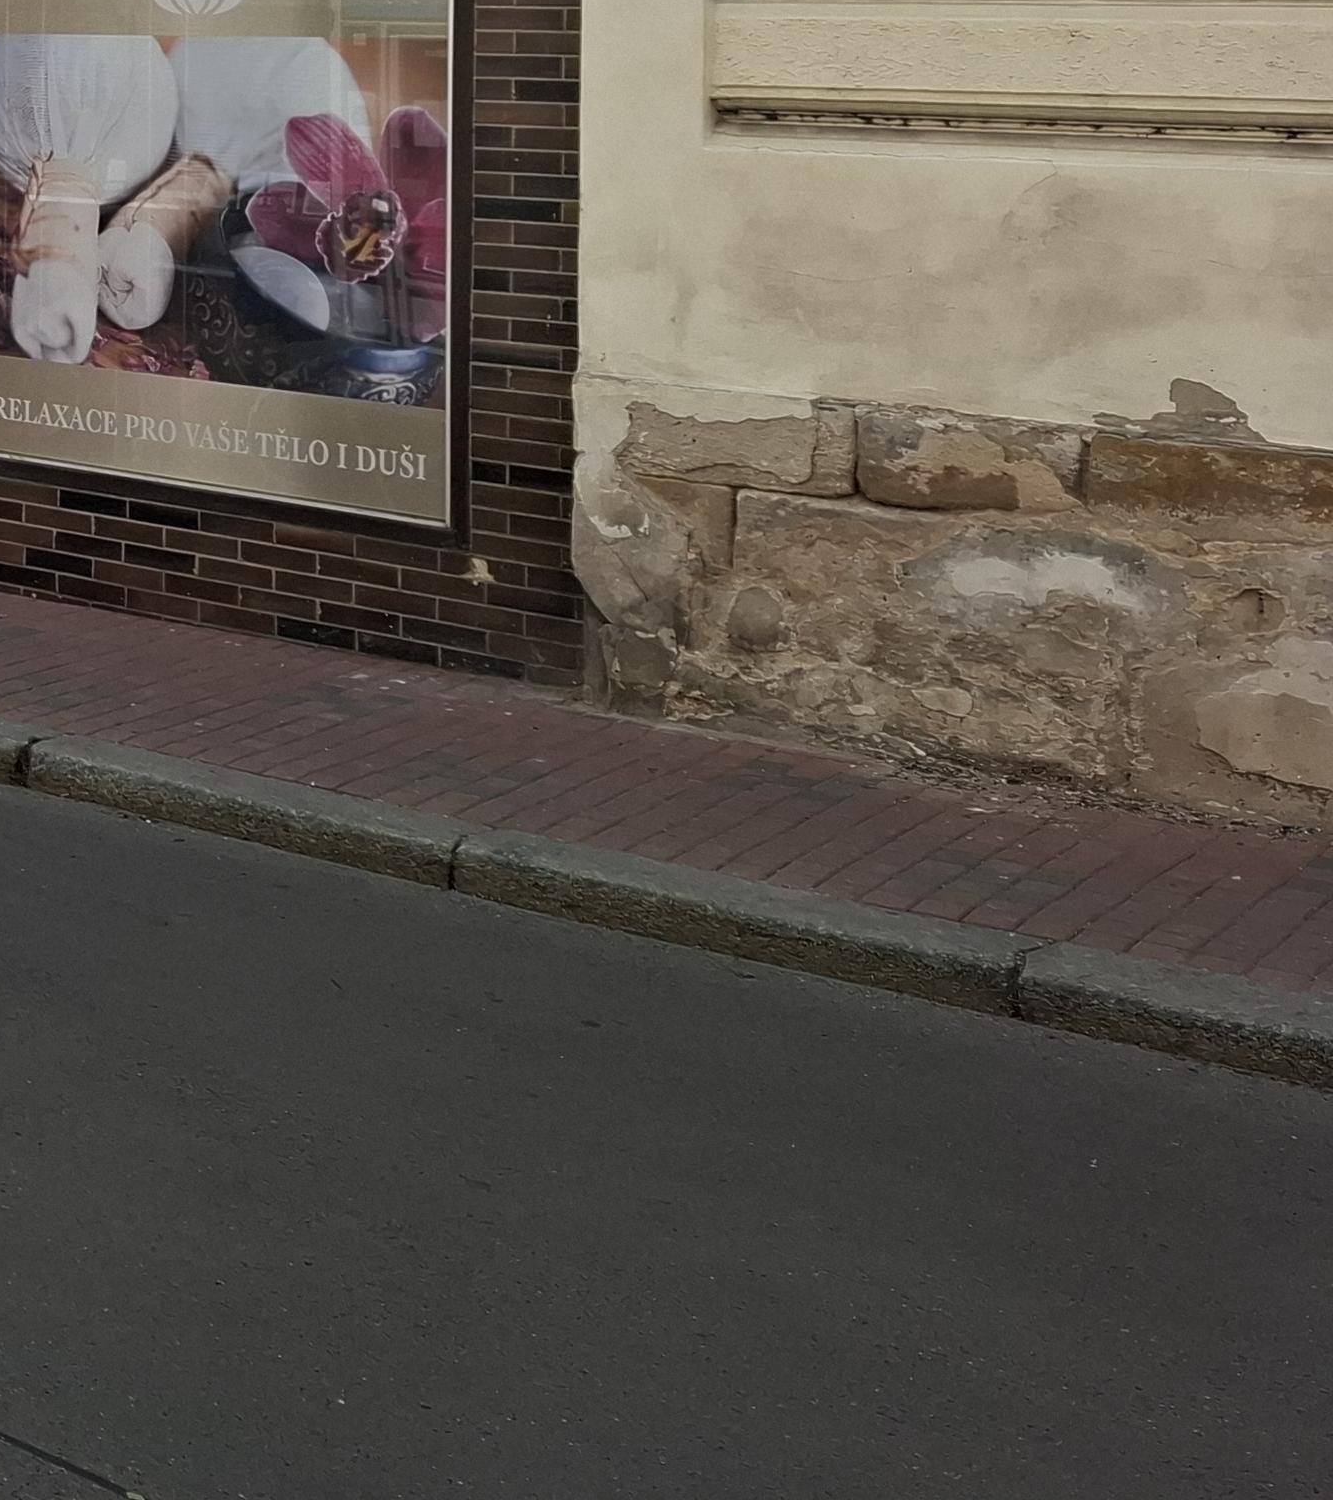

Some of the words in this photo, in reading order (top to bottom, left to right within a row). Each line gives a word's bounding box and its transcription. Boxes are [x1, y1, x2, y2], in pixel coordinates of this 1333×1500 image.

[124, 413, 177, 444] PRO
[184, 420, 249, 455] VAŠE
[255, 428, 330, 467] TĚLO
[337, 443, 348, 469] I
[355, 444, 427, 481] DUŠI
